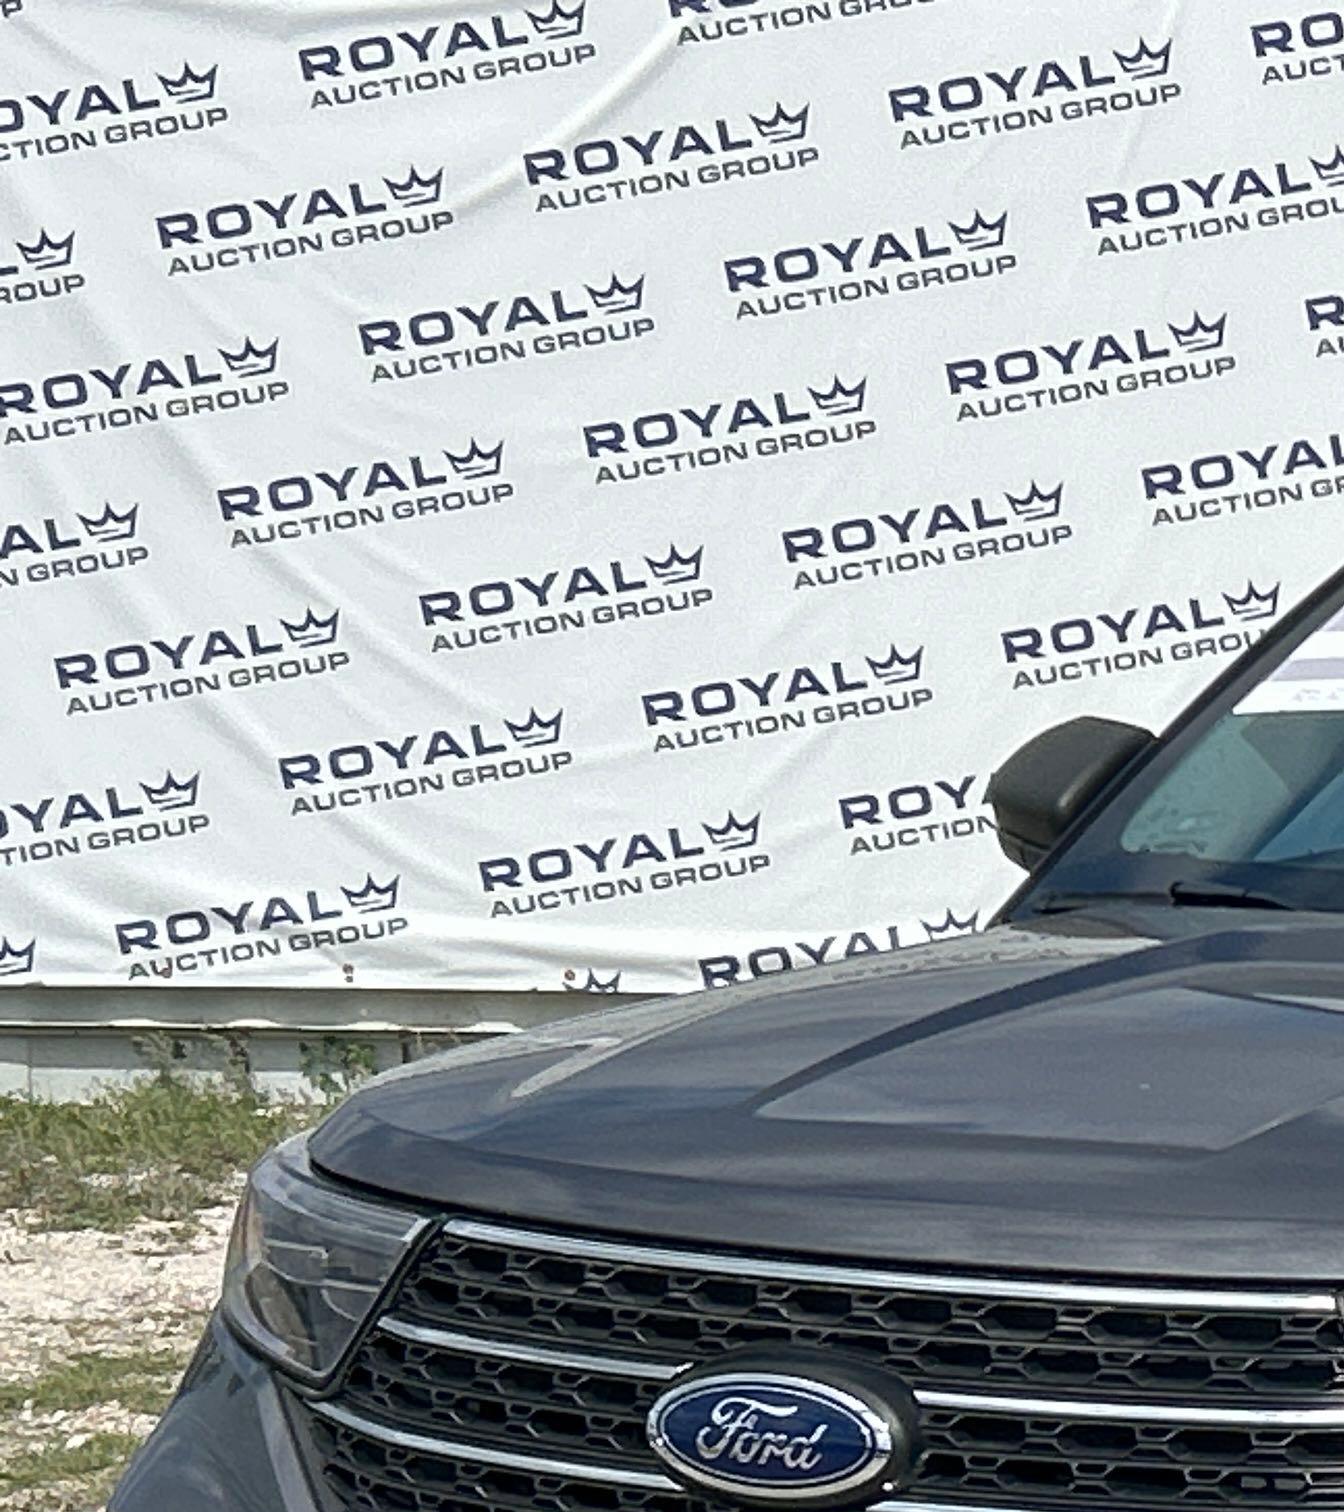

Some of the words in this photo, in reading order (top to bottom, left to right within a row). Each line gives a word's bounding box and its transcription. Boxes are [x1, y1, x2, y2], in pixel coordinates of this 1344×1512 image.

[298, 15, 530, 82] ROYAL
[676, 1, 832, 47] AUCTION
[0, 78, 161, 134] OYAL
[310, 65, 467, 109] AUCTION
[472, 43, 597, 81] GROUP
[887, 55, 1116, 124] ROYAL
[103, 107, 229, 144] GROUP
[900, 105, 1054, 151] AUCTION
[1060, 82, 1182, 121] GROUP
[522, 119, 754, 186] ROYAL
[535, 169, 691, 213] AUCTION
[696, 147, 819, 185] GROUP
[154, 182, 388, 250] ROYAL
[1085, 162, 1313, 230] ROYAL
[167, 232, 324, 277] AUCTION
[330, 210, 454, 248] GROUP
[723, 226, 952, 294] ROYAL
[1097, 211, 1250, 256] AUCTION
[736, 275, 890, 321] AUCTION
[896, 254, 1017, 292] GROUP
[357, 290, 589, 357] ROYAL
[371, 339, 526, 383] AUCTION
[532, 317, 655, 355] GROUP
[0, 354, 223, 419] ROYAL
[944, 328, 1171, 396] ROYAL
[956, 378, 1109, 423] AUCTION
[1116, 356, 1236, 393] GROUP
[3, 402, 159, 446] AUCTION
[165, 381, 289, 418] GROUP
[582, 391, 812, 459] ROYAL
[595, 441, 749, 485] AUCTION
[755, 420, 877, 457] GROUP
[216, 455, 448, 522] ROYAL
[230, 505, 385, 549] AUCTION
[391, 483, 514, 520] GROUP
[1152, 482, 1303, 527] AUCTION
[781, 497, 1008, 564] ROYAL
[793, 547, 946, 591] AUCTION
[952, 524, 1073, 562] GROUP
[26, 545, 149, 583] GROUP
[418, 560, 649, 627] ROYAL
[431, 610, 585, 653] AUCTION
[591, 588, 713, 625] GROUP
[1000, 597, 1226, 664] ROYAL
[53, 624, 284, 690] ROYAL
[66, 673, 221, 716] AUCTION
[227, 651, 350, 688] GROUP
[1012, 646, 1164, 690] AUCTION
[641, 661, 869, 727] ROYAL
[653, 709, 807, 753] AUCTION
[812, 688, 933, 724] GROUP
[277, 724, 508, 791] ROYAL
[291, 773, 445, 817] AUCTION
[451, 751, 573, 788] GROUP
[86, 814, 210, 851] GROUP
[838, 775, 977, 830] ROY
[477, 827, 705, 893] ROYAL
[490, 876, 643, 919] AUCTION
[649, 854, 771, 890] GROUP
[114, 890, 344, 956] ROYAL
[128, 937, 281, 981] AUCTION
[287, 917, 409, 952] GROUP
[696, 1395, 829, 1472] Ford
